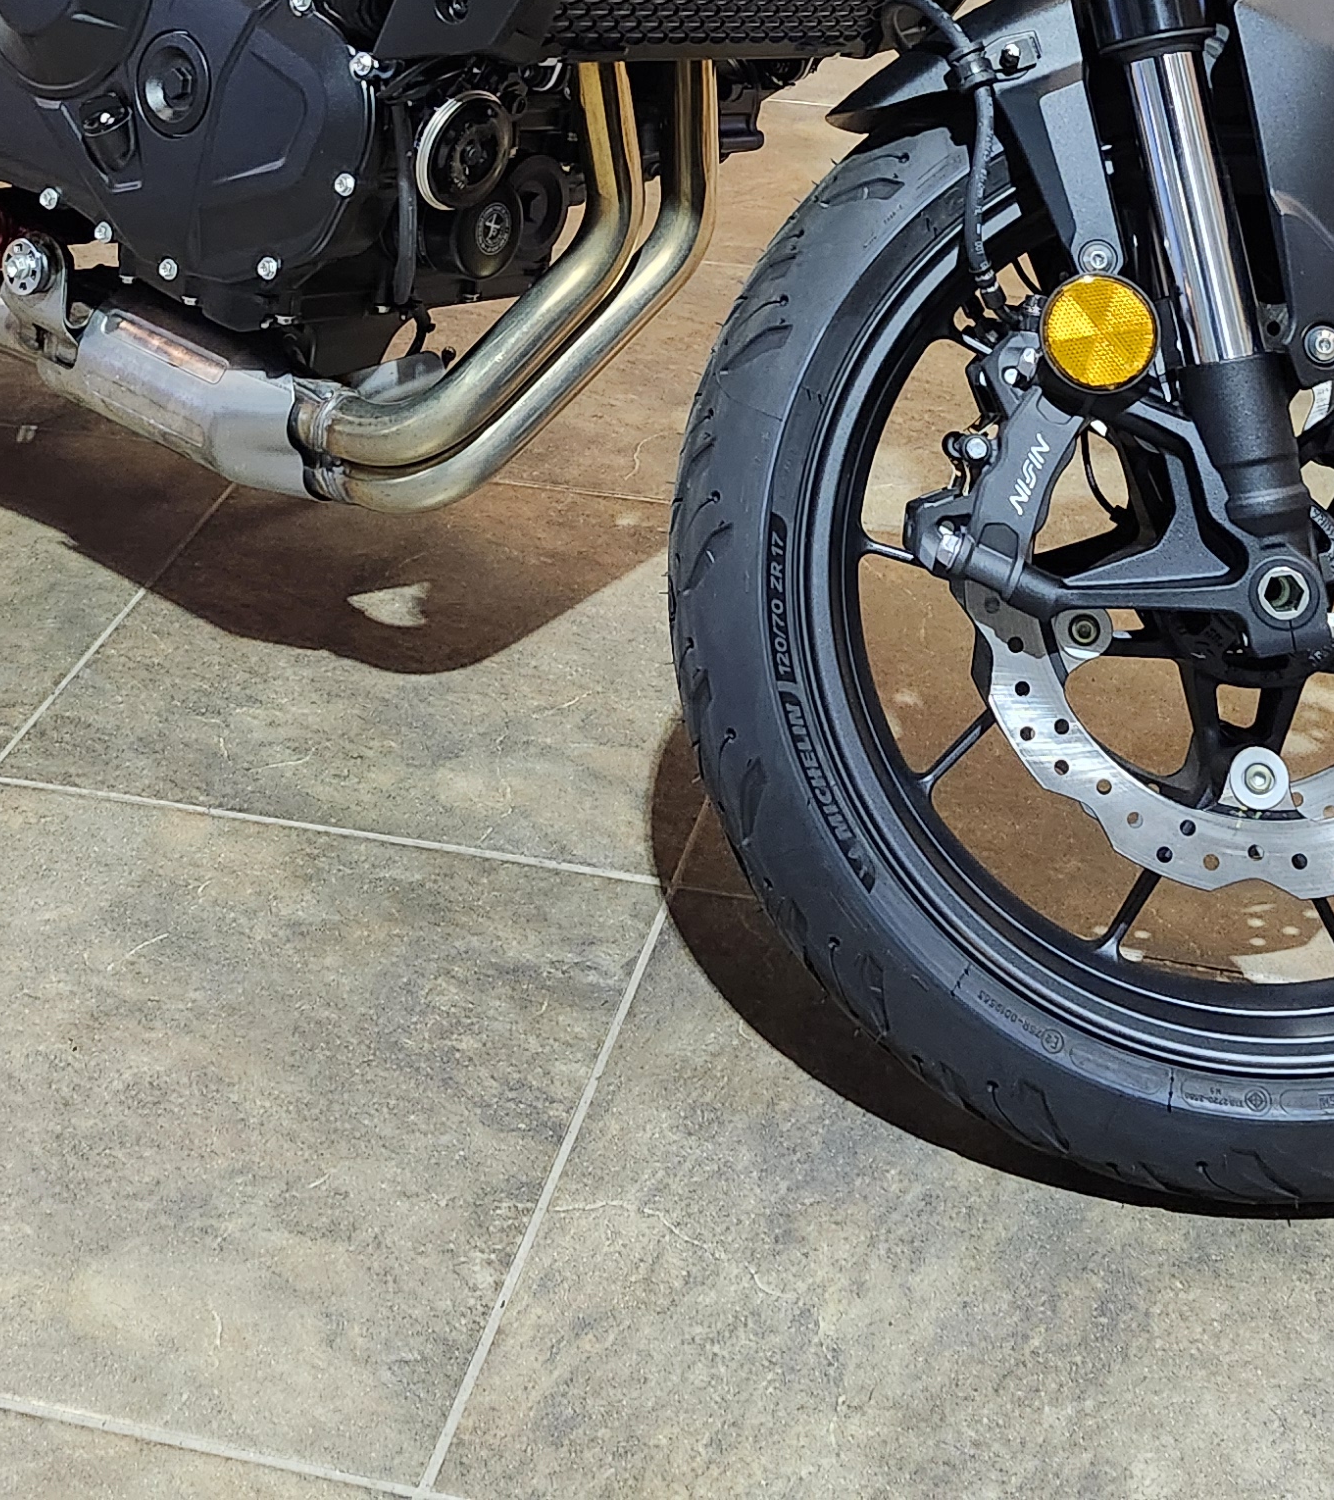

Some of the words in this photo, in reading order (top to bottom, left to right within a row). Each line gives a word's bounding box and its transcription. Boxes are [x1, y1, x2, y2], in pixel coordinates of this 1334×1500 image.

[1008, 432, 1051, 516] NISSIN
[770, 560, 784, 592] ZR
[771, 531, 784, 549] 17
[771, 600, 792, 675] 120/70
[785, 701, 856, 842] MICHELIN
